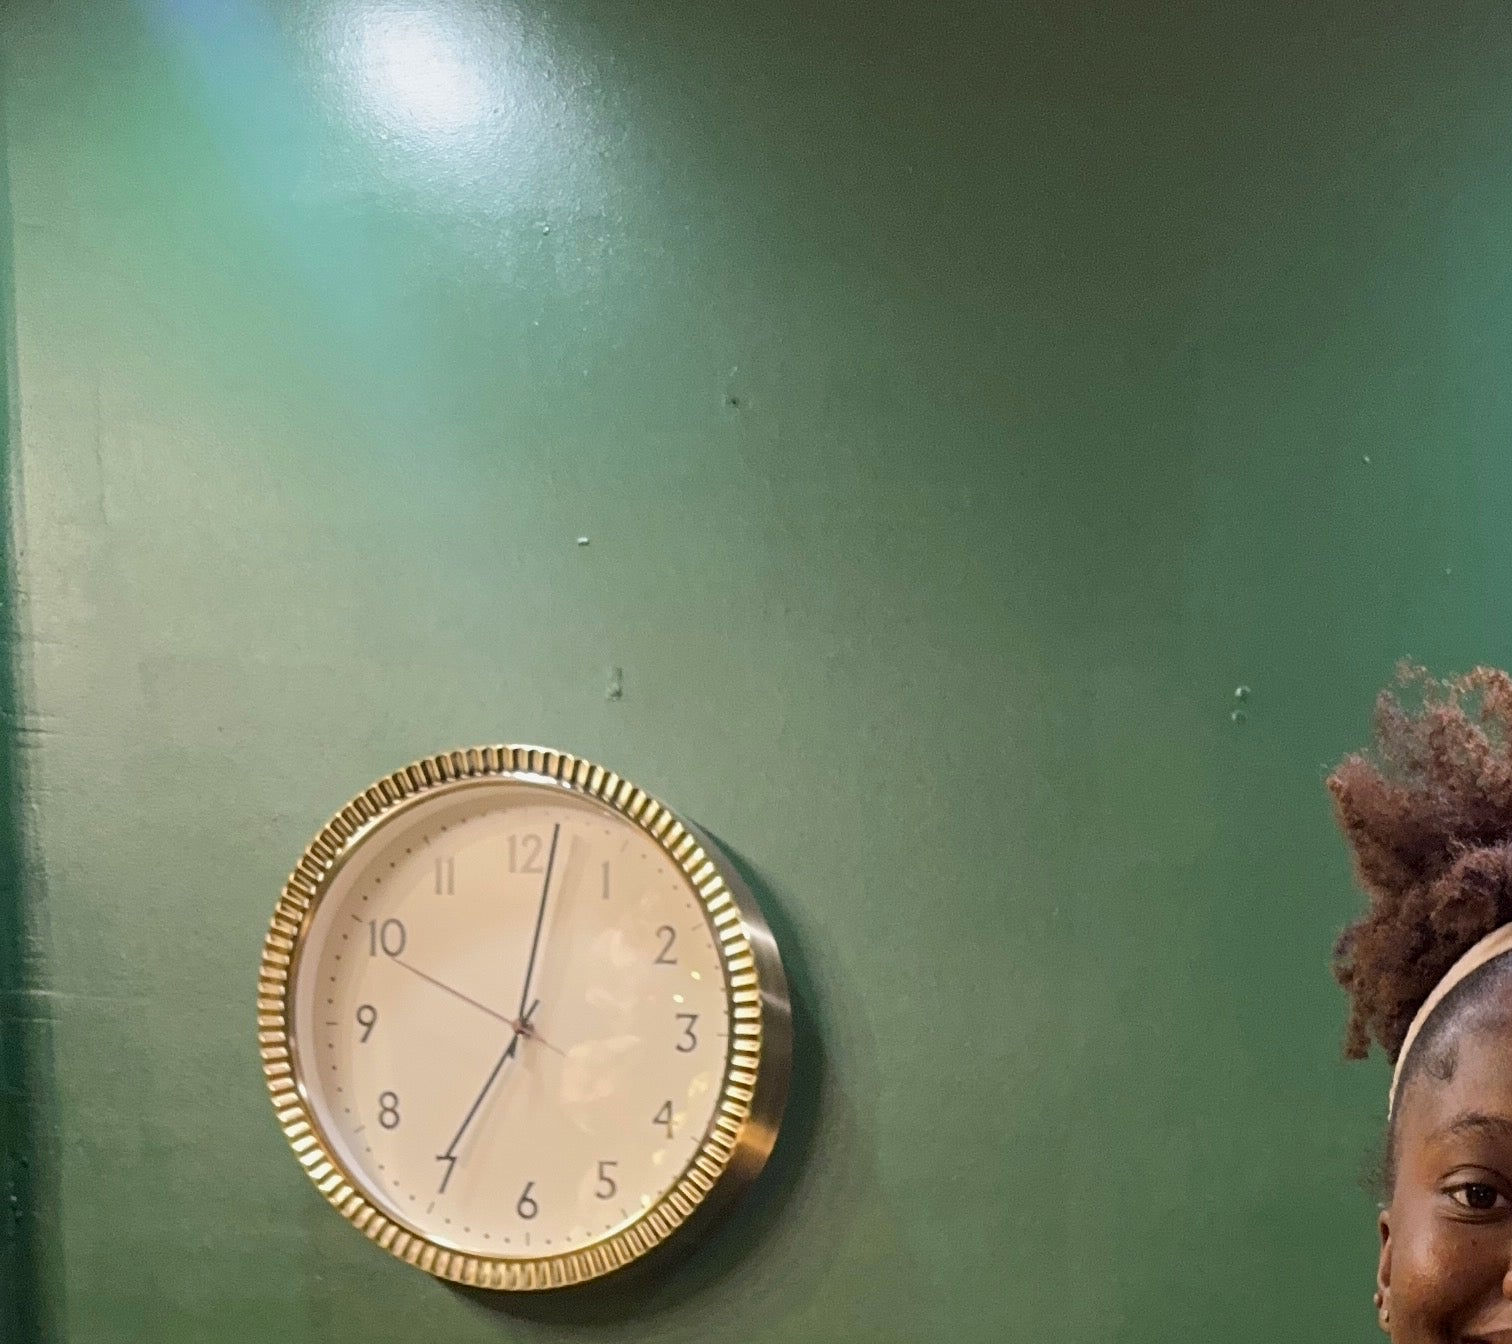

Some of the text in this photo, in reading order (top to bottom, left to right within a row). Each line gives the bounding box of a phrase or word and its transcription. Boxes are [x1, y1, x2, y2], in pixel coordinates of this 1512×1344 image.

[506, 834, 544, 874] 12
[434, 857, 455, 895] 11
[601, 861, 610, 899] 1
[369, 918, 406, 957] 10
[654, 925, 678, 965] 2
[355, 1004, 378, 1044] 9
[674, 1014, 699, 1053] 3
[379, 1091, 400, 1130] 8
[652, 1100, 679, 1139] 4
[435, 1155, 457, 1194] 7
[595, 1160, 618, 1199] 5
[517, 1181, 538, 1219] 6
